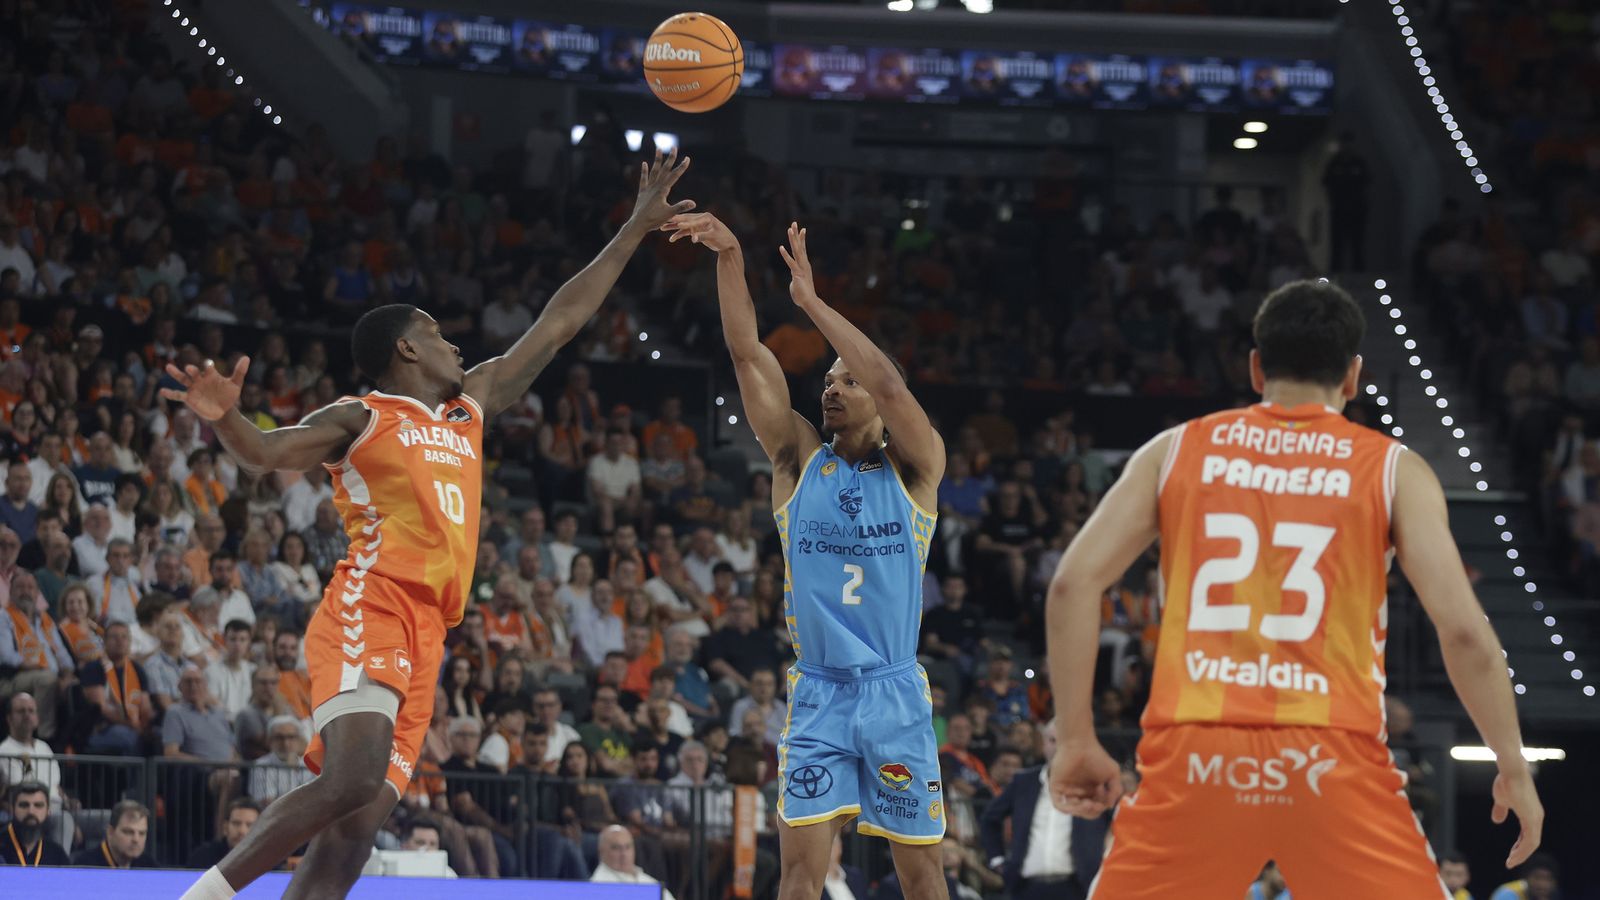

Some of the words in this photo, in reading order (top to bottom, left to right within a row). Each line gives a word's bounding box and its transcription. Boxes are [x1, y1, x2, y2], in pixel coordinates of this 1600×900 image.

[646, 42, 701, 63] Wilson
[1211, 417, 1353, 459] CÁRDENAS
[424, 449, 462, 467] BASKET
[1202, 455, 1351, 497] PAMESA
[433, 480, 465, 525] 10
[799, 519, 902, 540] DREAMLAND
[815, 540, 905, 557] GranCanaria
[842, 563, 864, 606] 2
[1187, 512, 1337, 643] 23
[1185, 649, 1329, 695] Vitaldin
[1187, 753, 1288, 791] MGS
[875, 804, 894, 816] del
[896, 806, 919, 820] Mar
[876, 789, 920, 808] Poema
